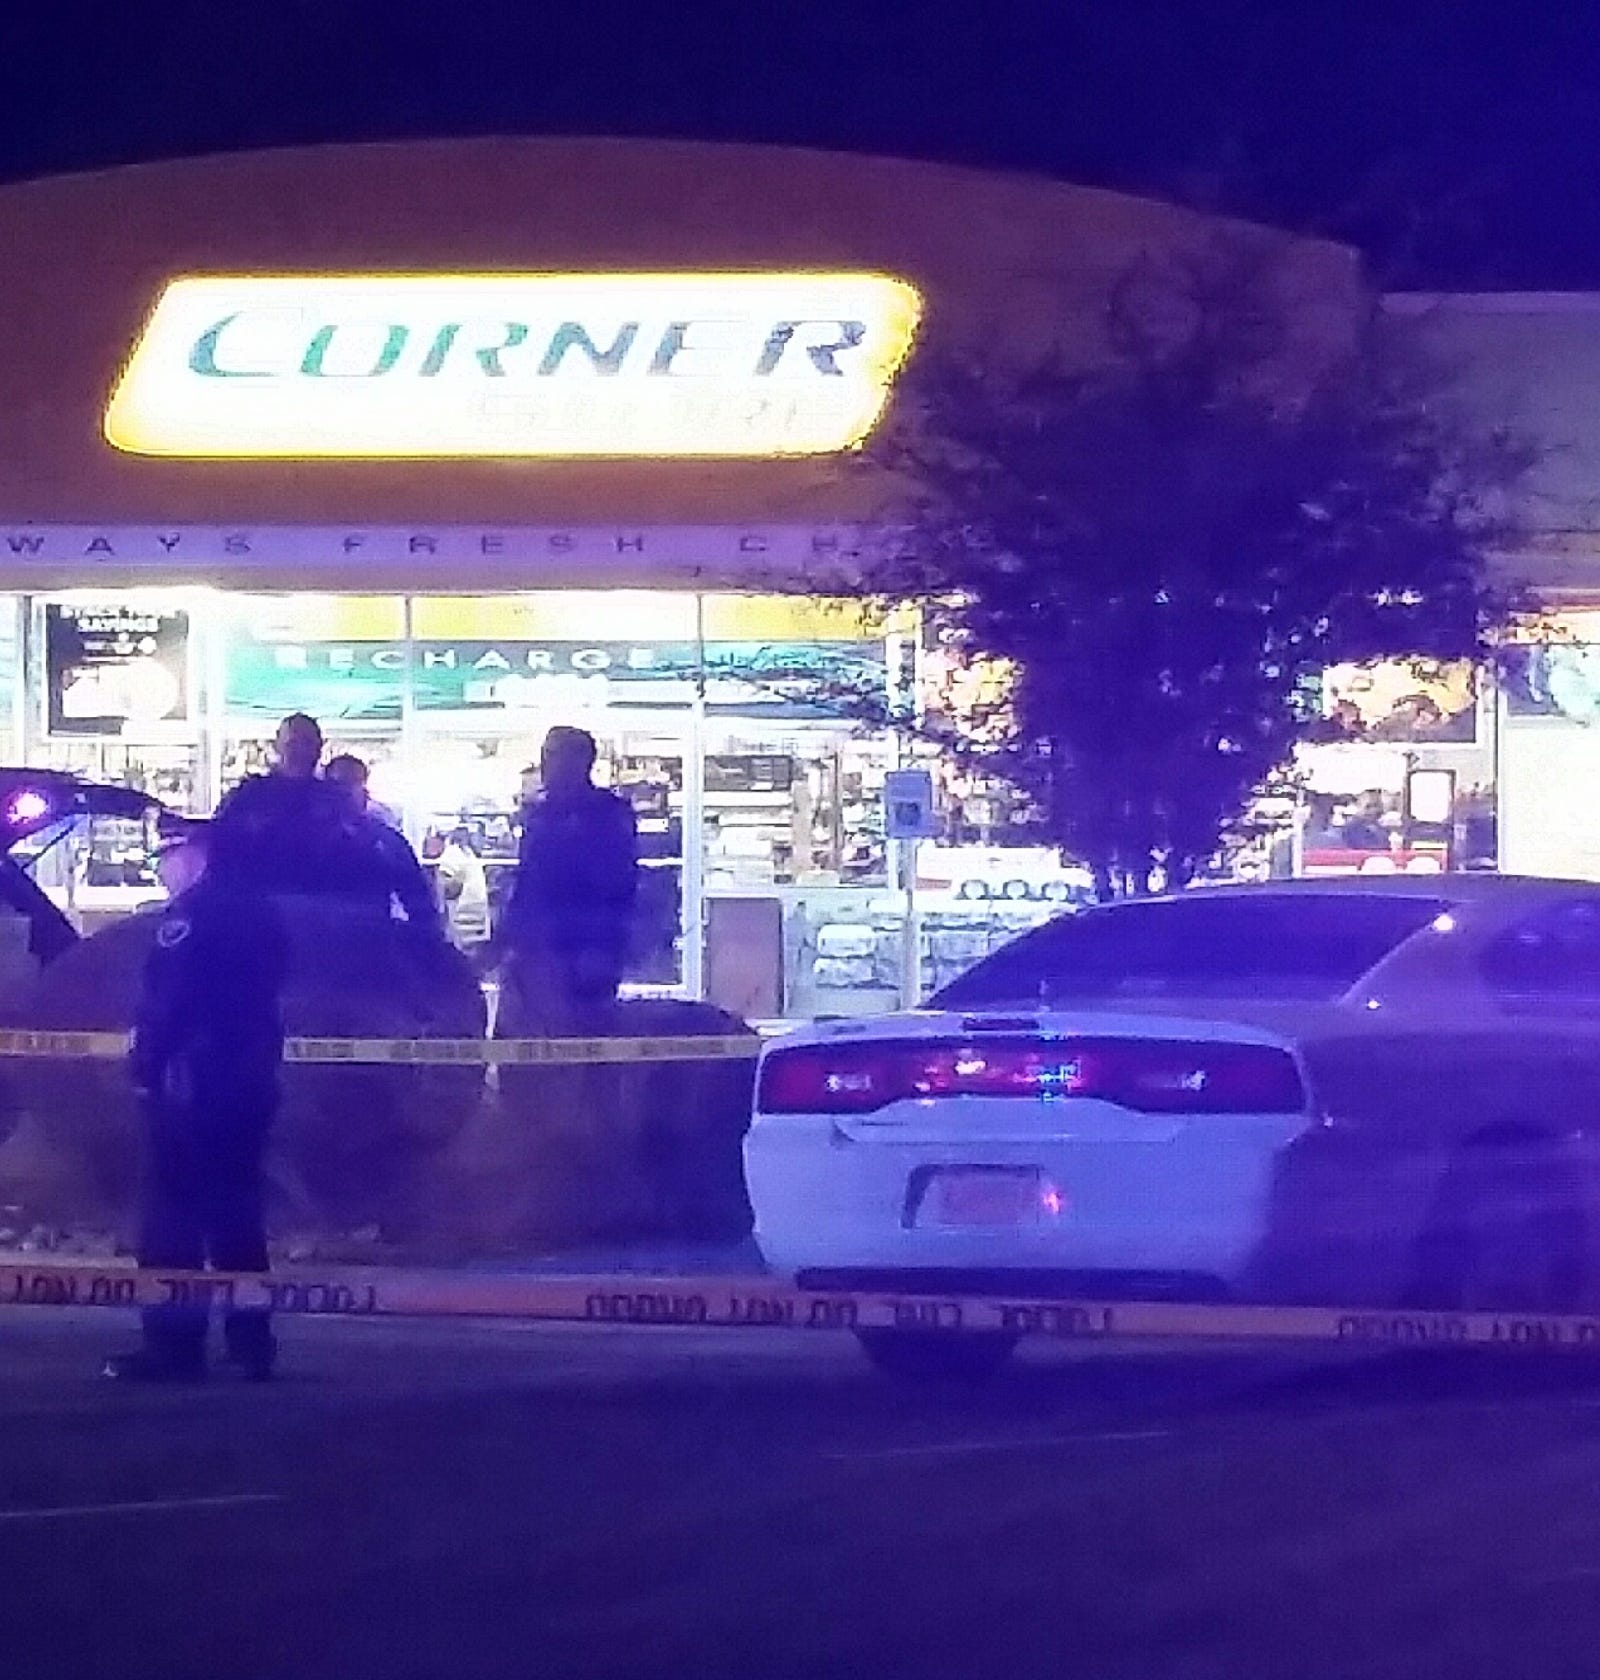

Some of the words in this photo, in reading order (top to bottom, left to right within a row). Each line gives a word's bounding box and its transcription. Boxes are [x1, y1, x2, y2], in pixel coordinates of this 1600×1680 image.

[186, 309, 869, 378] CORNER
[342, 533, 645, 555] FRESH
[274, 647, 656, 671] RECHARGE
